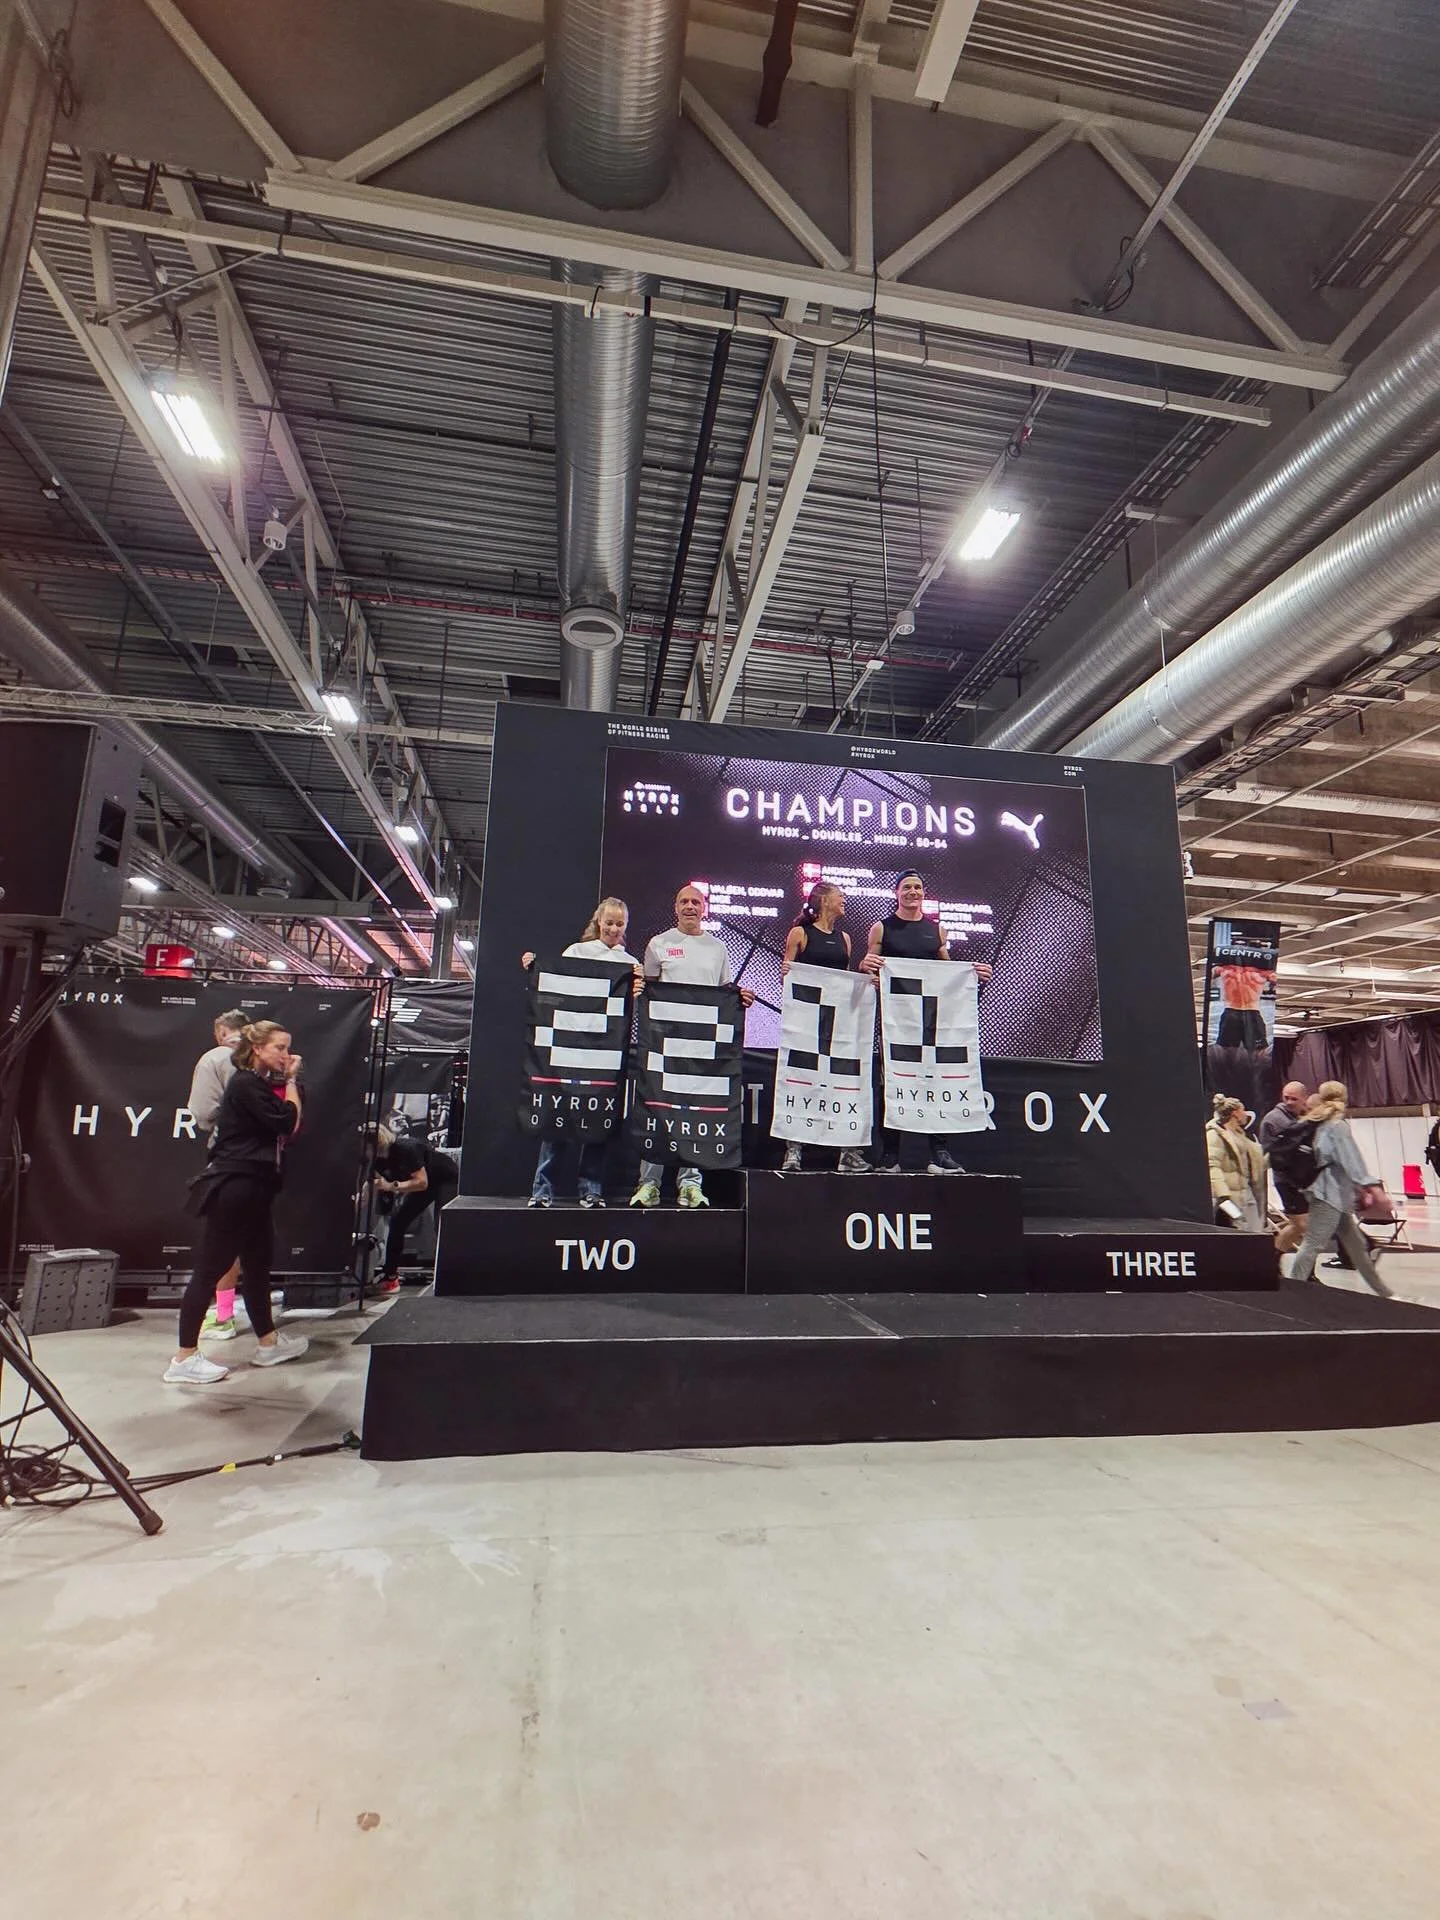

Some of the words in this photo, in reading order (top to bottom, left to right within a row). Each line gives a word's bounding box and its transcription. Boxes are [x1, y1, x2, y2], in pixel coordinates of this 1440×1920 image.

[607, 722, 620, 730] THE
[621, 724, 644, 732] WORLD
[645, 726, 669, 734] SERIES
[617, 730, 645, 738] FITNESS
[646, 732, 670, 740] RACING
[726, 787, 976, 836] CHAMPIONS
[762, 825, 800, 838] HYROX
[812, 829, 863, 843] DOUBLES
[874, 834, 908, 847] MIXED
[1221, 948, 1262, 959] CENTR
[58, 991, 123, 1004] HYROX
[533, 1093, 616, 1111] HYROX
[896, 1087, 969, 1103] HYROX
[786, 1094, 858, 1114] HYROX
[897, 1105, 970, 1119] OSLO
[531, 1114, 613, 1129] OSLO
[646, 1117, 726, 1137] HYROX
[785, 1114, 857, 1131] OSLO
[644, 1138, 725, 1155] OSLO
[845, 1212, 933, 1251] ONE
[555, 1239, 636, 1271] TWO
[1106, 1251, 1197, 1277] THREE
